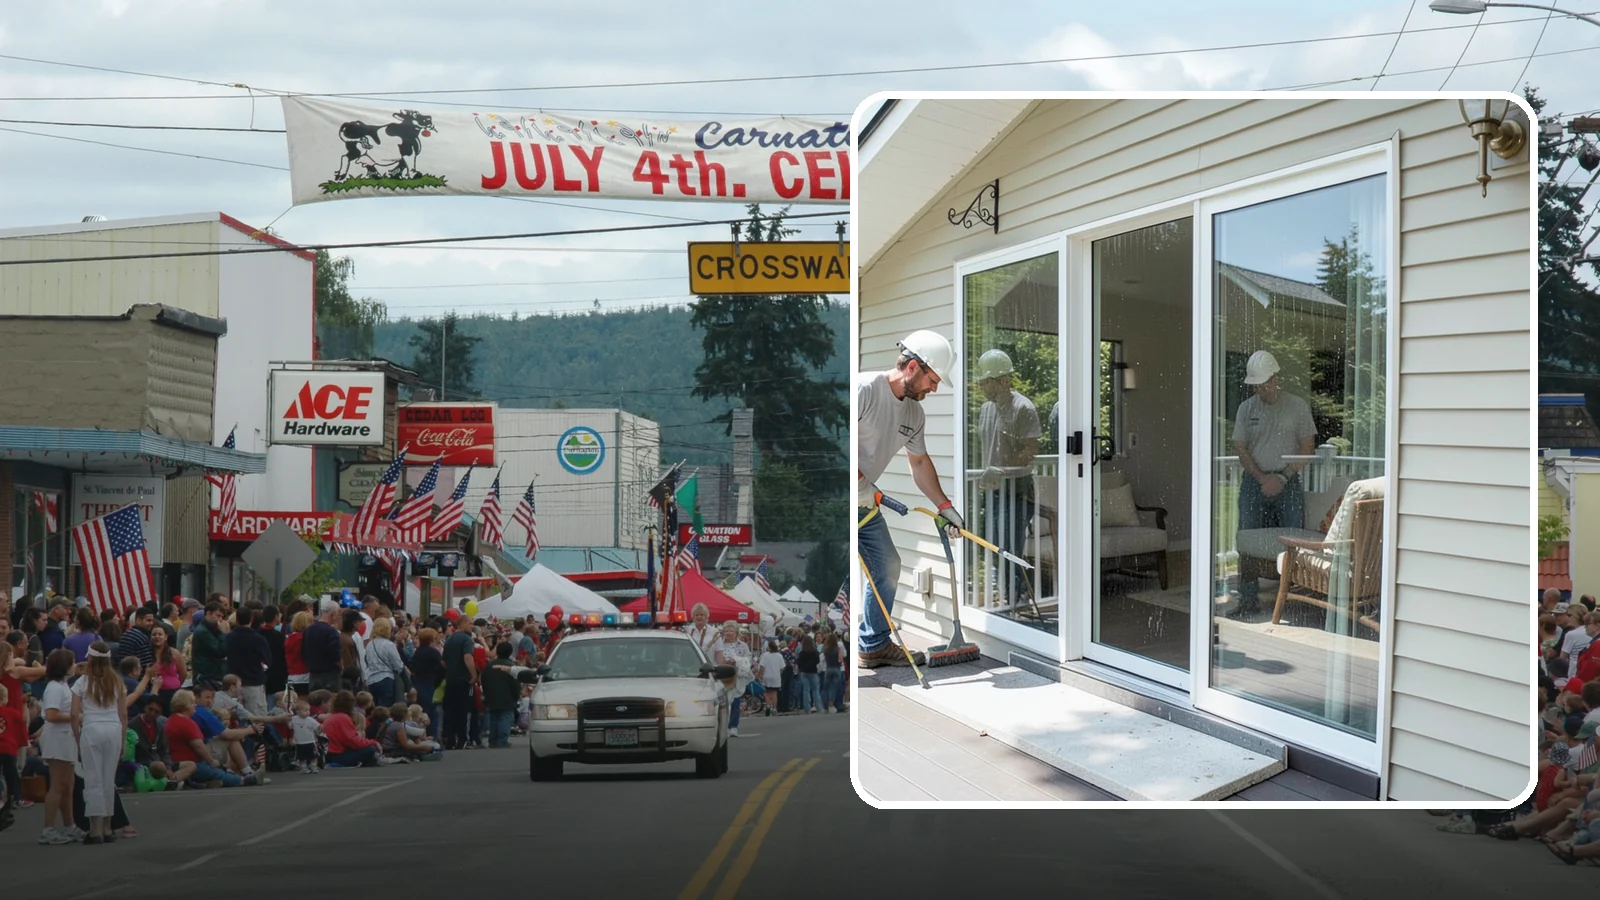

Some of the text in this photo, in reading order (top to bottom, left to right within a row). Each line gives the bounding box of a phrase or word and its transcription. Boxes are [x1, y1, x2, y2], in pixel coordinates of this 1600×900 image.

[695, 121, 850, 149] Carnat
[481, 141, 605, 193] JULY
[632, 150, 746, 198] 4th.
[696, 253, 850, 280] CROSSWA
[283, 380, 373, 420] ACE
[405, 409, 453, 422] CEDAR
[283, 421, 371, 436] Hardware
[416, 428, 477, 447] Coca-Cola
[95, 485, 125, 495] Vincent
[126, 486, 136, 495] de
[138, 486, 155, 495] Paul
[688, 526, 742, 535] CRNATION
[699, 535, 730, 543] GLASS
